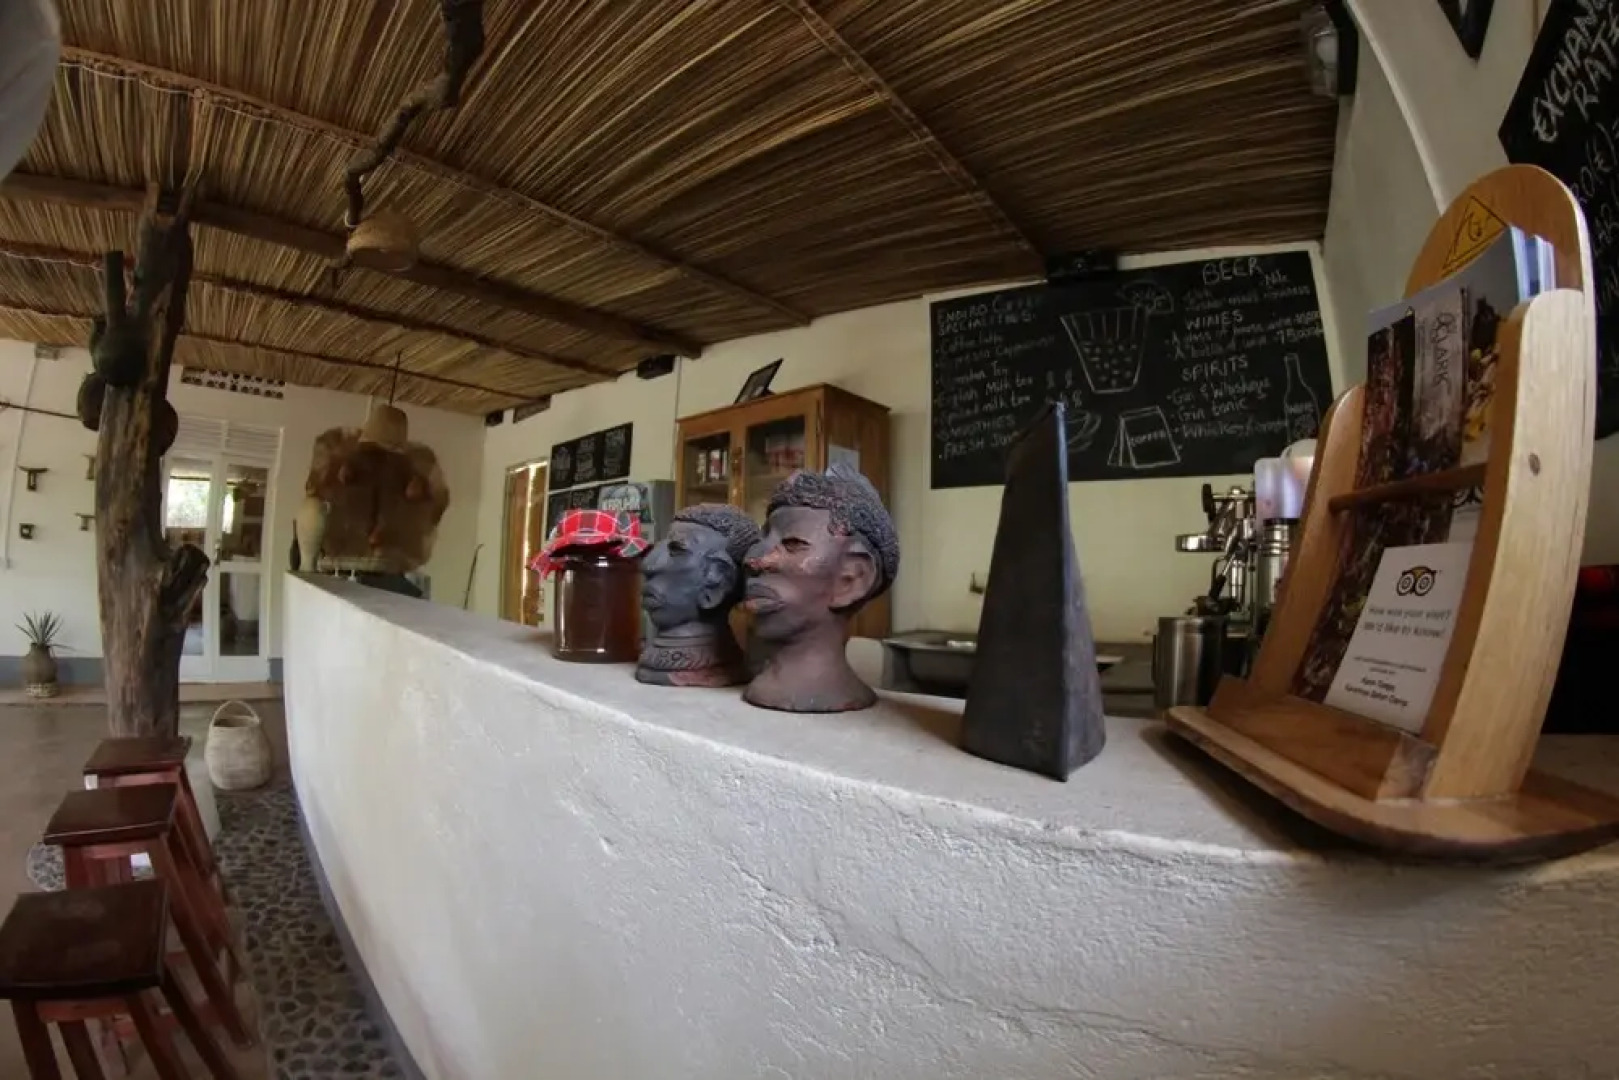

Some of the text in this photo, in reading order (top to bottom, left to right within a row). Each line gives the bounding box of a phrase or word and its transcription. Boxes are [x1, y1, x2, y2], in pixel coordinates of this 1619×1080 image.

[1202, 257, 1264, 286] BEER
[1185, 309, 1243, 331] WINES
[1182, 353, 1249, 382] SPIRITS
[1178, 397, 1249, 422] Gin tonic
